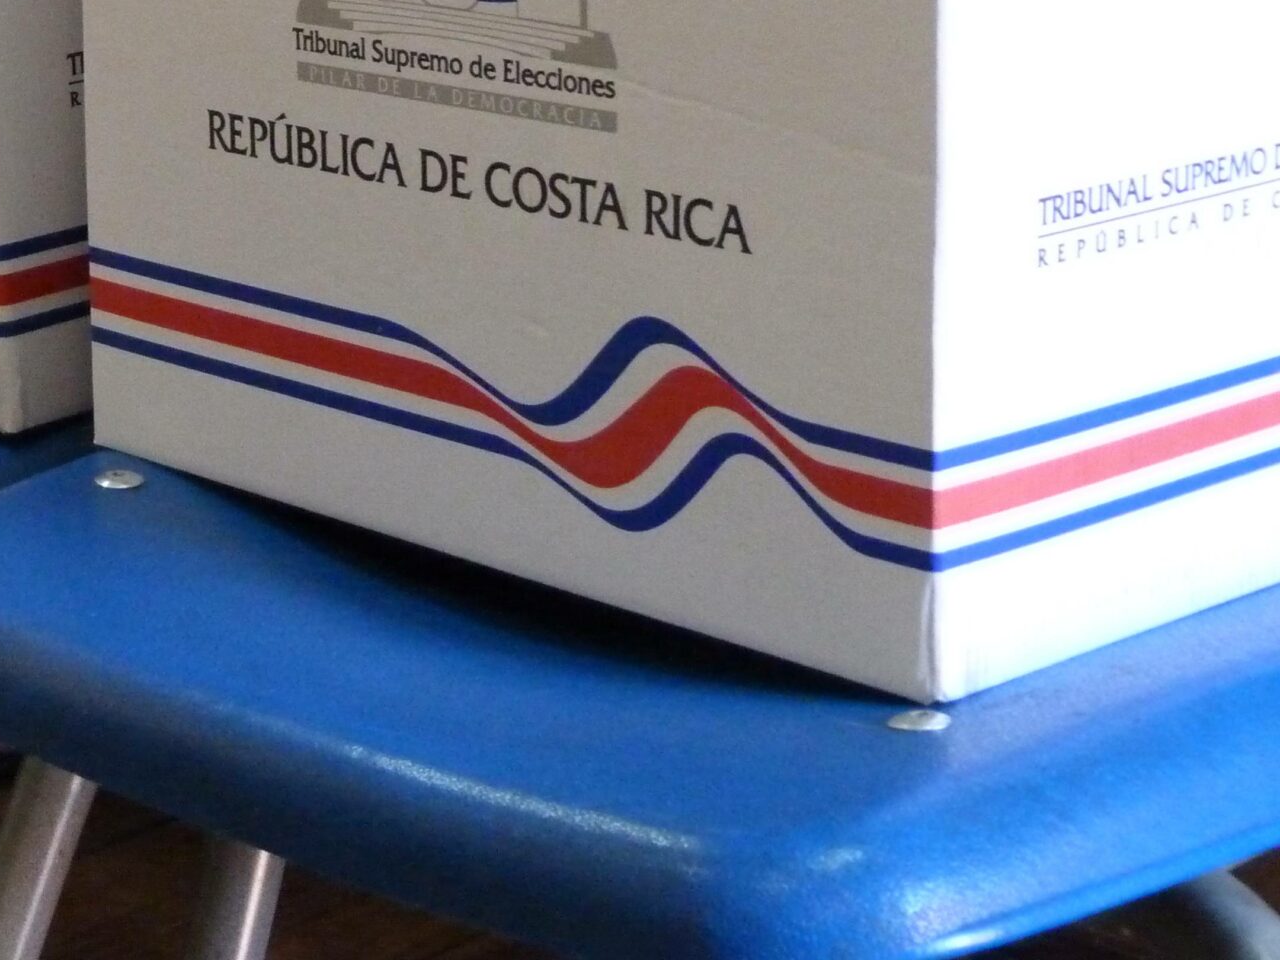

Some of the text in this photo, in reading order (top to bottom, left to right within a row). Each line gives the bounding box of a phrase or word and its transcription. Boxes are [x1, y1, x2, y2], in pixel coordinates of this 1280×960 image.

[292, 27, 616, 99] Tribunal Supremo de Elecciones
[308, 66, 602, 129] PILAR DE LA DEMOCRACIA
[207, 109, 753, 254] REPÚBLICA DE COSTA RICA
[1038, 174, 1153, 225] TRIBUNAL
[1161, 147, 1267, 198] SUPREMO
[1223, 198, 1250, 222] DE
